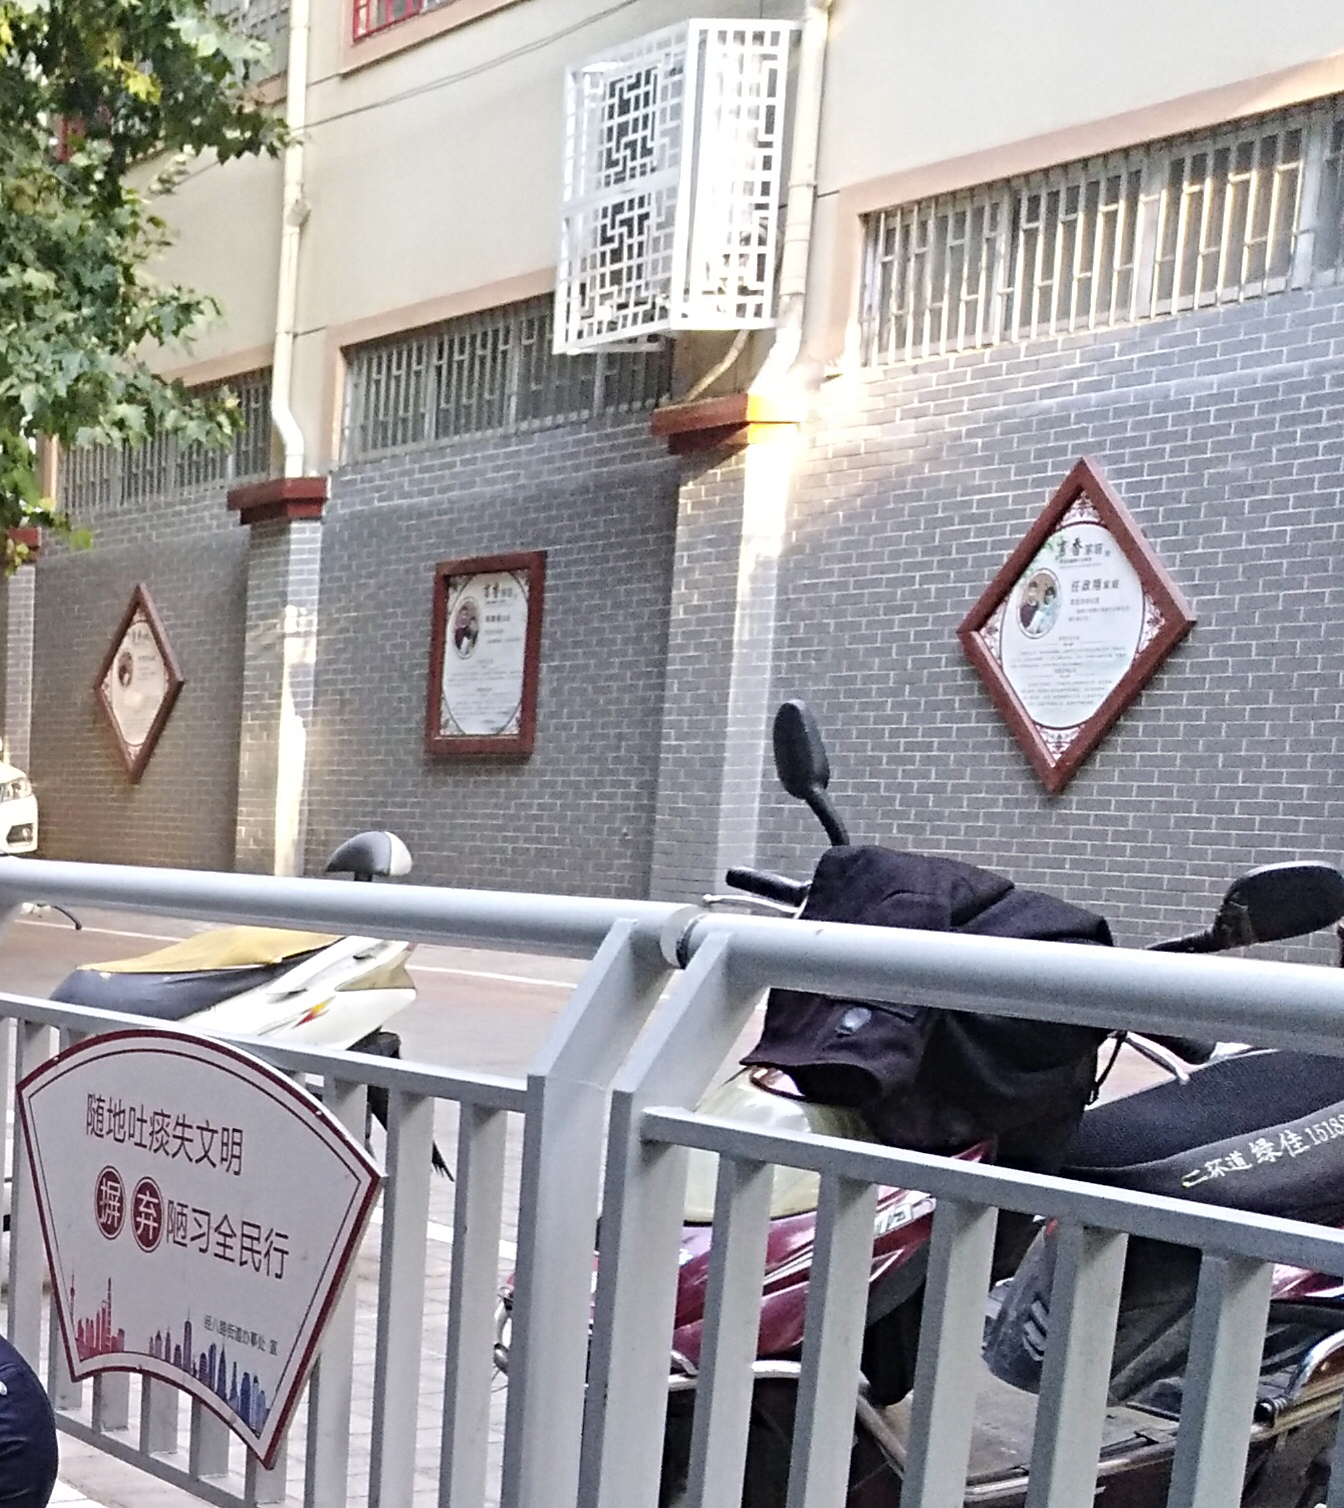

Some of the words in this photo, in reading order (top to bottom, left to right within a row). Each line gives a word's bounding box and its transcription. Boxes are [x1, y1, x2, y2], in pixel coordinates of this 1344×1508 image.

[85, 1093, 244, 1176] 随地吐痰失文明
[1180, 1150, 1253, 1188] 二环道
[99, 1175, 290, 1280] 摒弃陋习全民行
